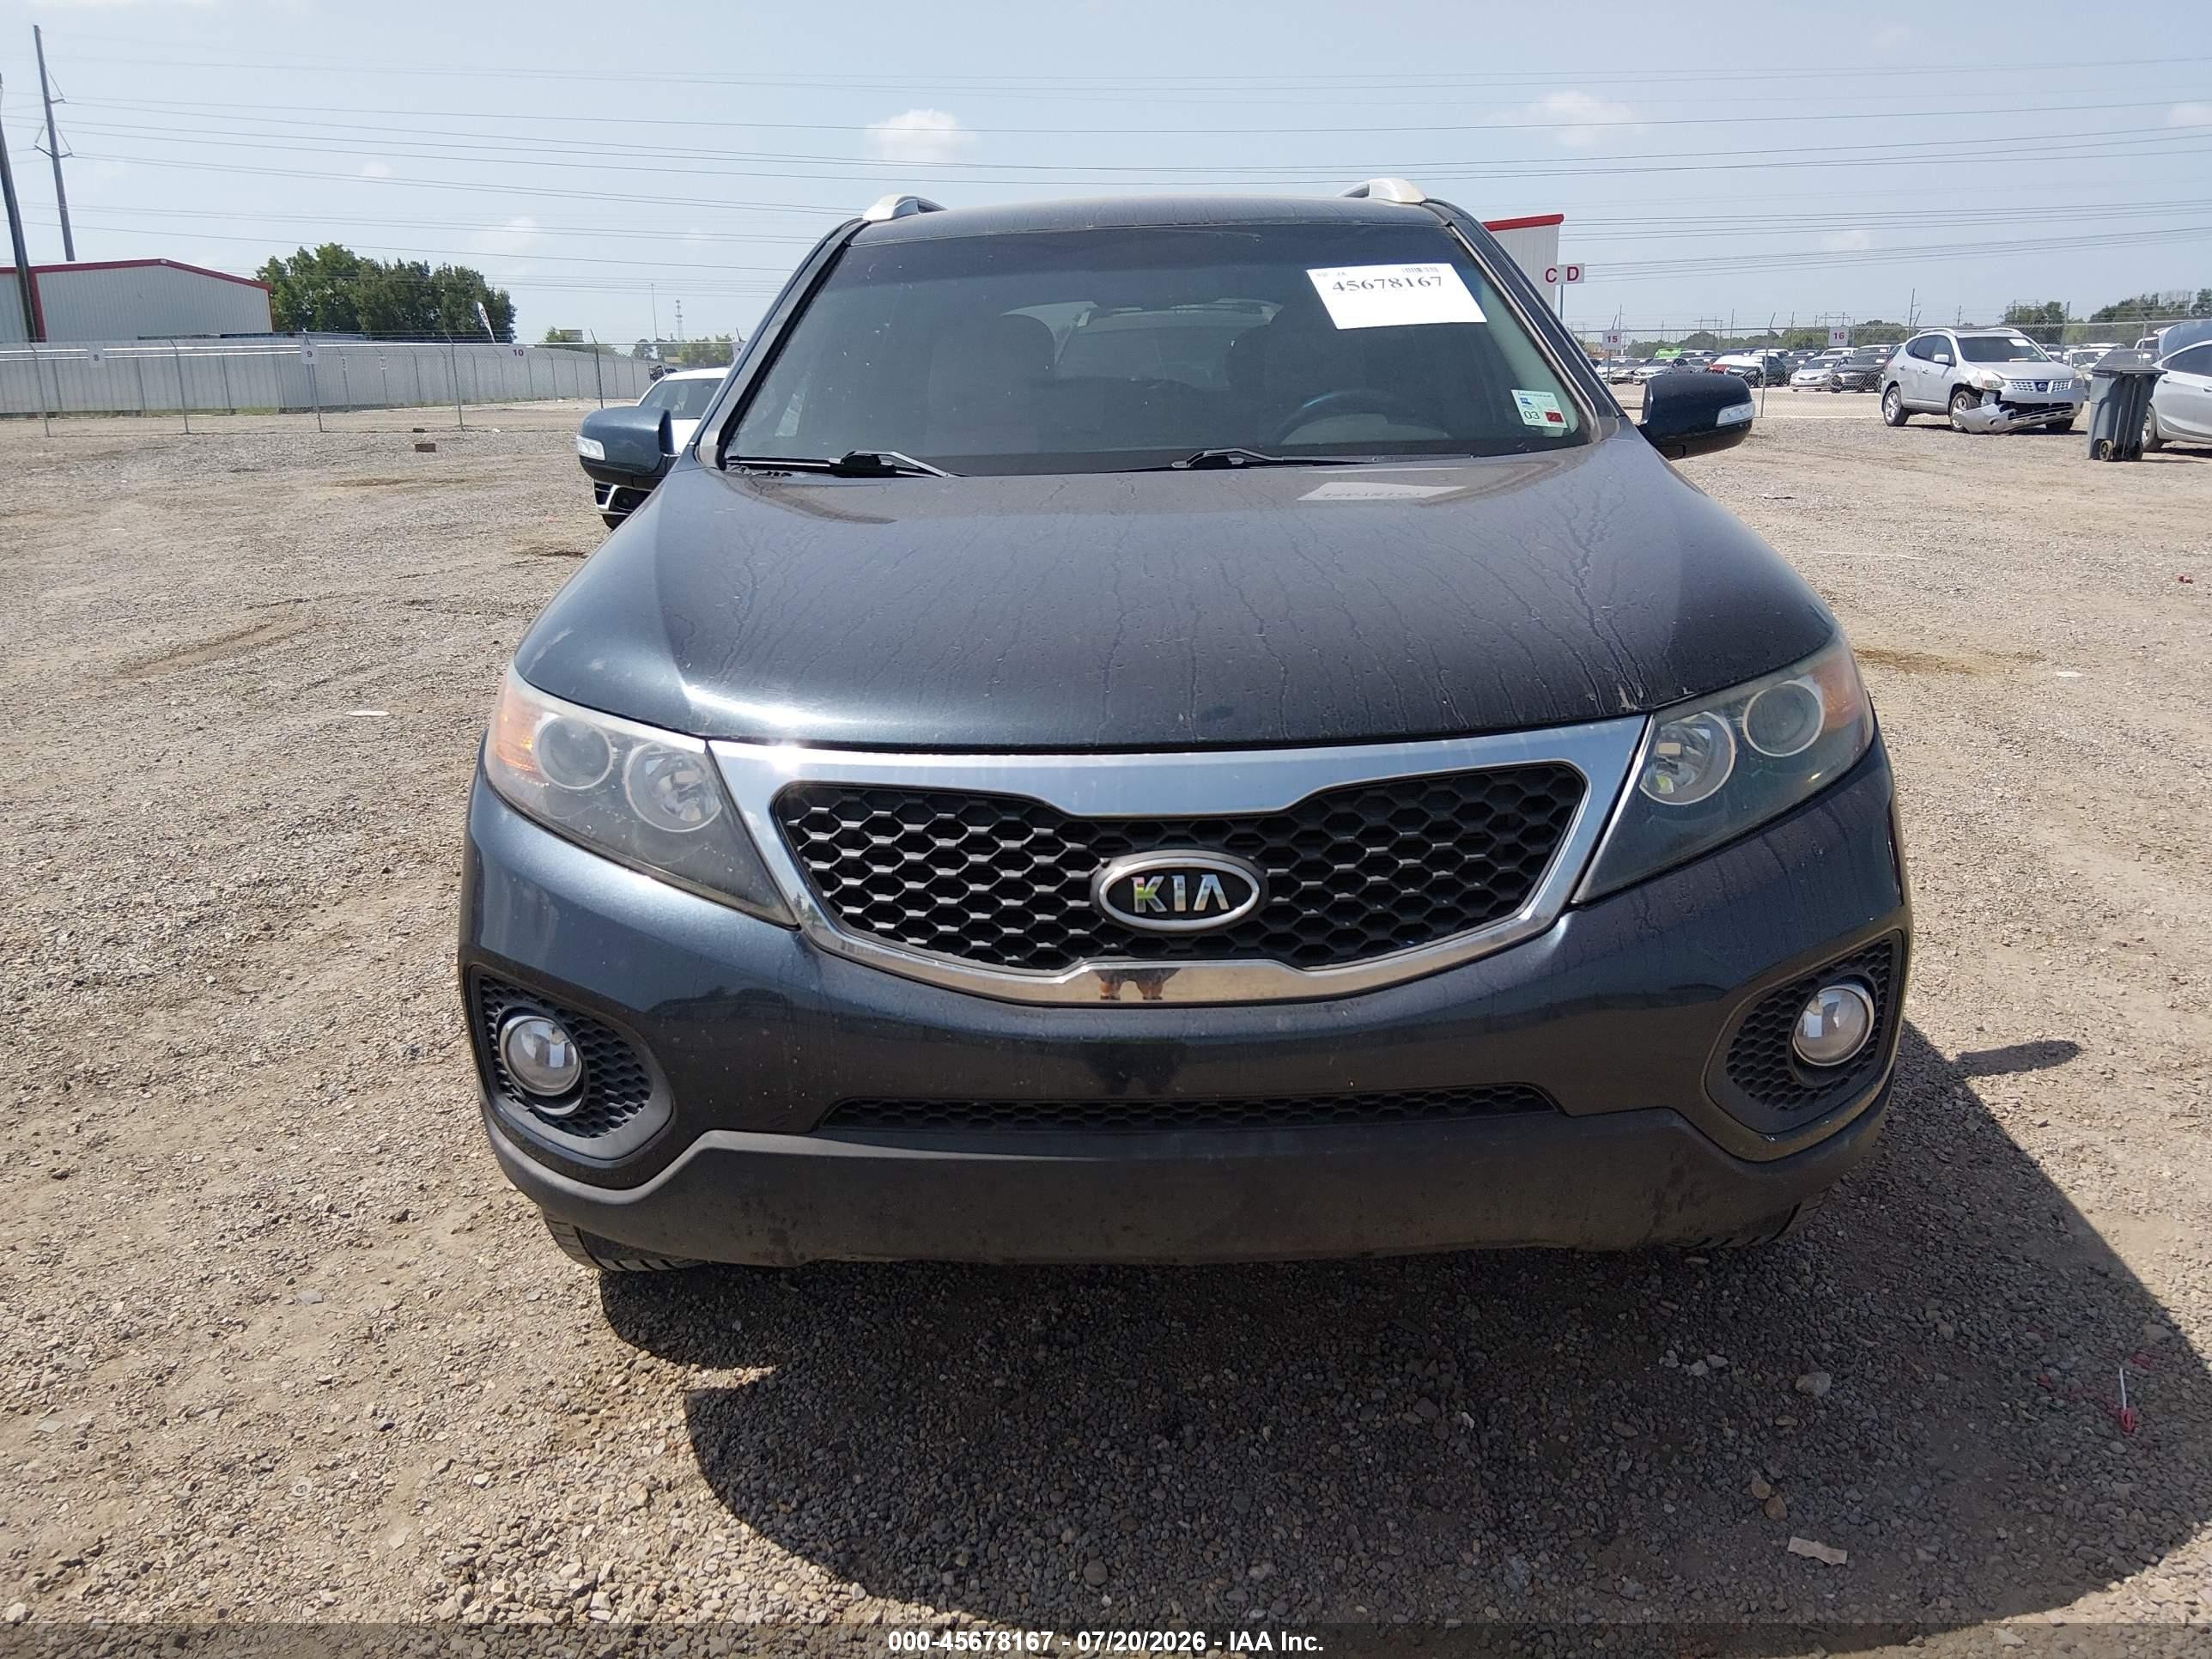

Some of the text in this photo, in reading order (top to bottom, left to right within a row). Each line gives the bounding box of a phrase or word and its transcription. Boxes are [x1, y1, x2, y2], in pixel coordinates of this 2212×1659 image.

[1545, 266, 1580, 283] C D
[1332, 276, 1442, 292] 45678167
[1607, 335, 1618, 343] 15
[1833, 331, 1844, 340] 16
[1523, 410, 1540, 420] 03
[1131, 873, 1231, 914] KIA
